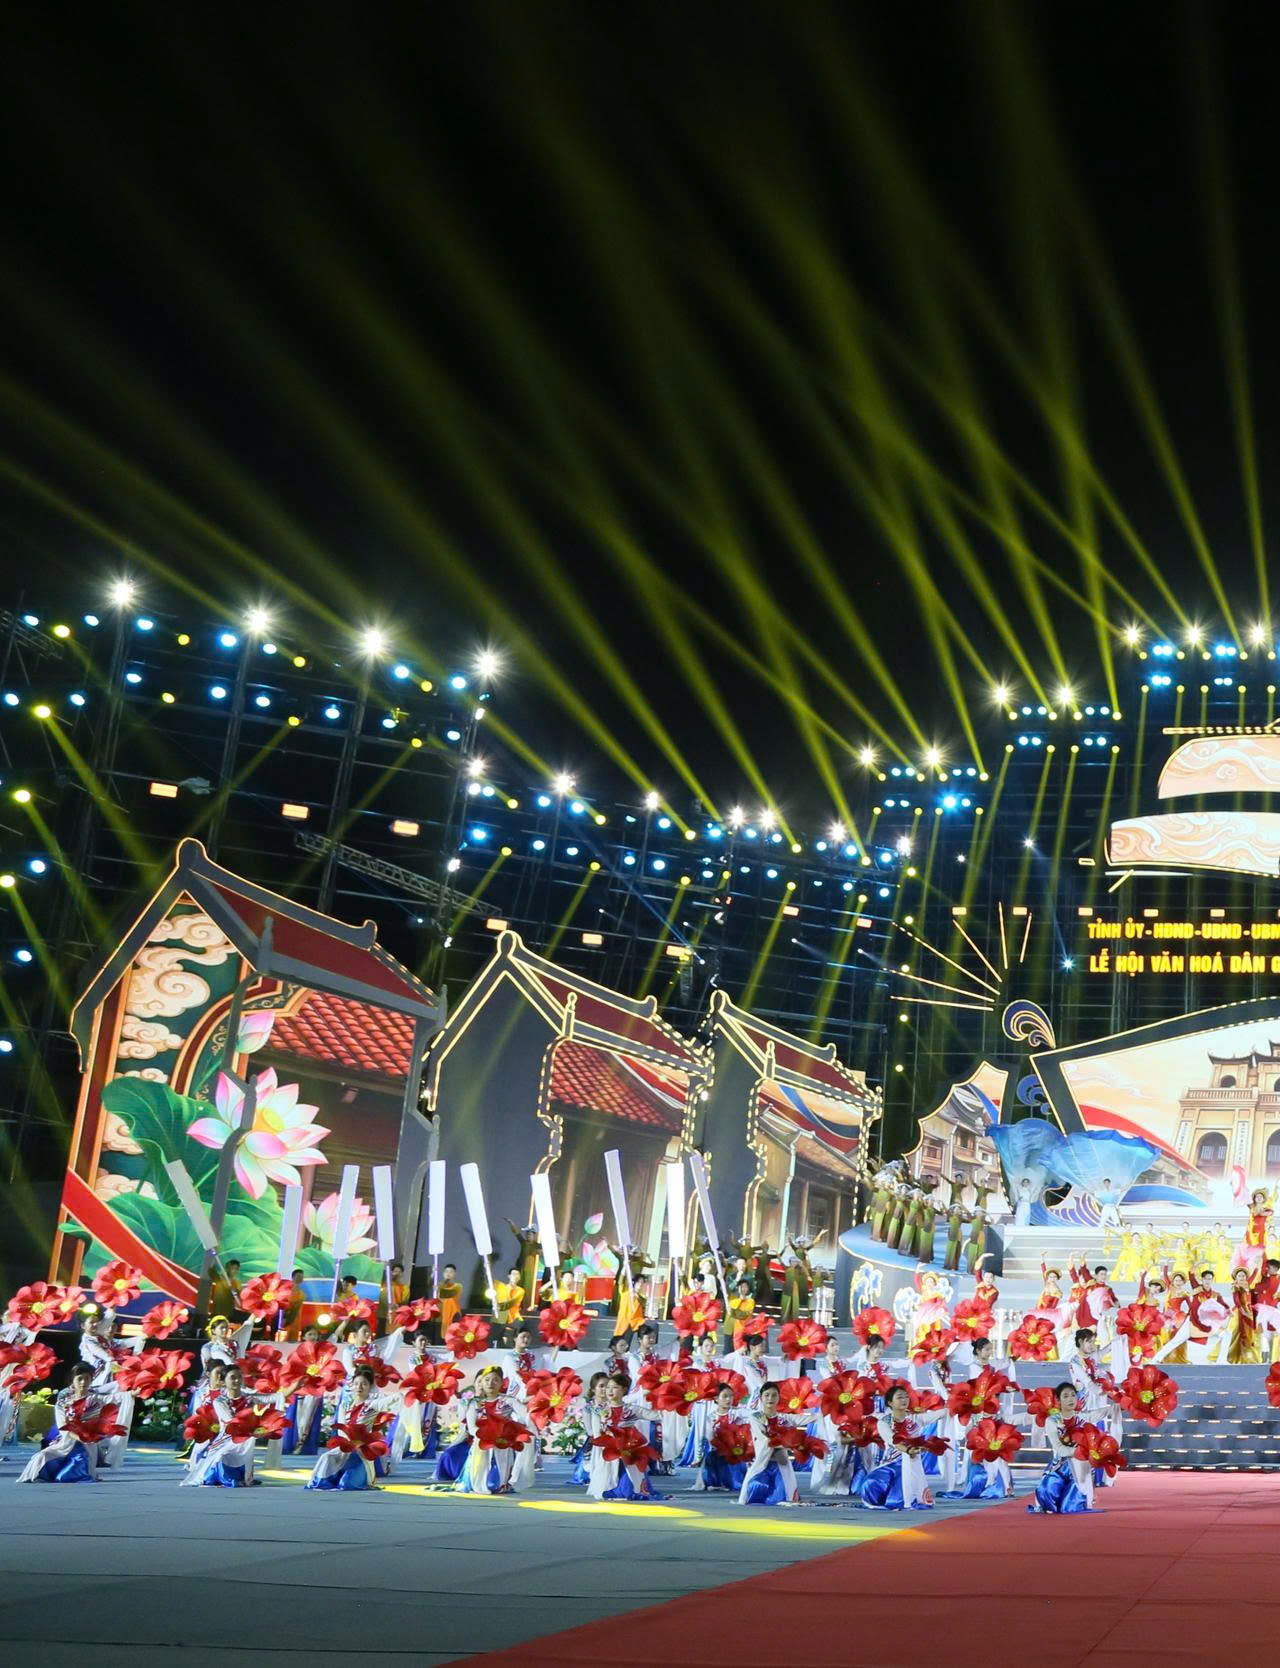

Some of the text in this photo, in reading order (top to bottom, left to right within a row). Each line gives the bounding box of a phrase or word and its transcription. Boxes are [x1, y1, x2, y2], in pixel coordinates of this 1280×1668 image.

[1088, 917, 1121, 939] TỈNH
[1201, 922, 1242, 939] UBND
[1089, 947, 1109, 973] LỄ
[1115, 950, 1144, 977] HỘI
[1150, 950, 1184, 973] VĂN
[1189, 951, 1224, 973] HOÁ
[1230, 951, 1266, 974] DÂN
